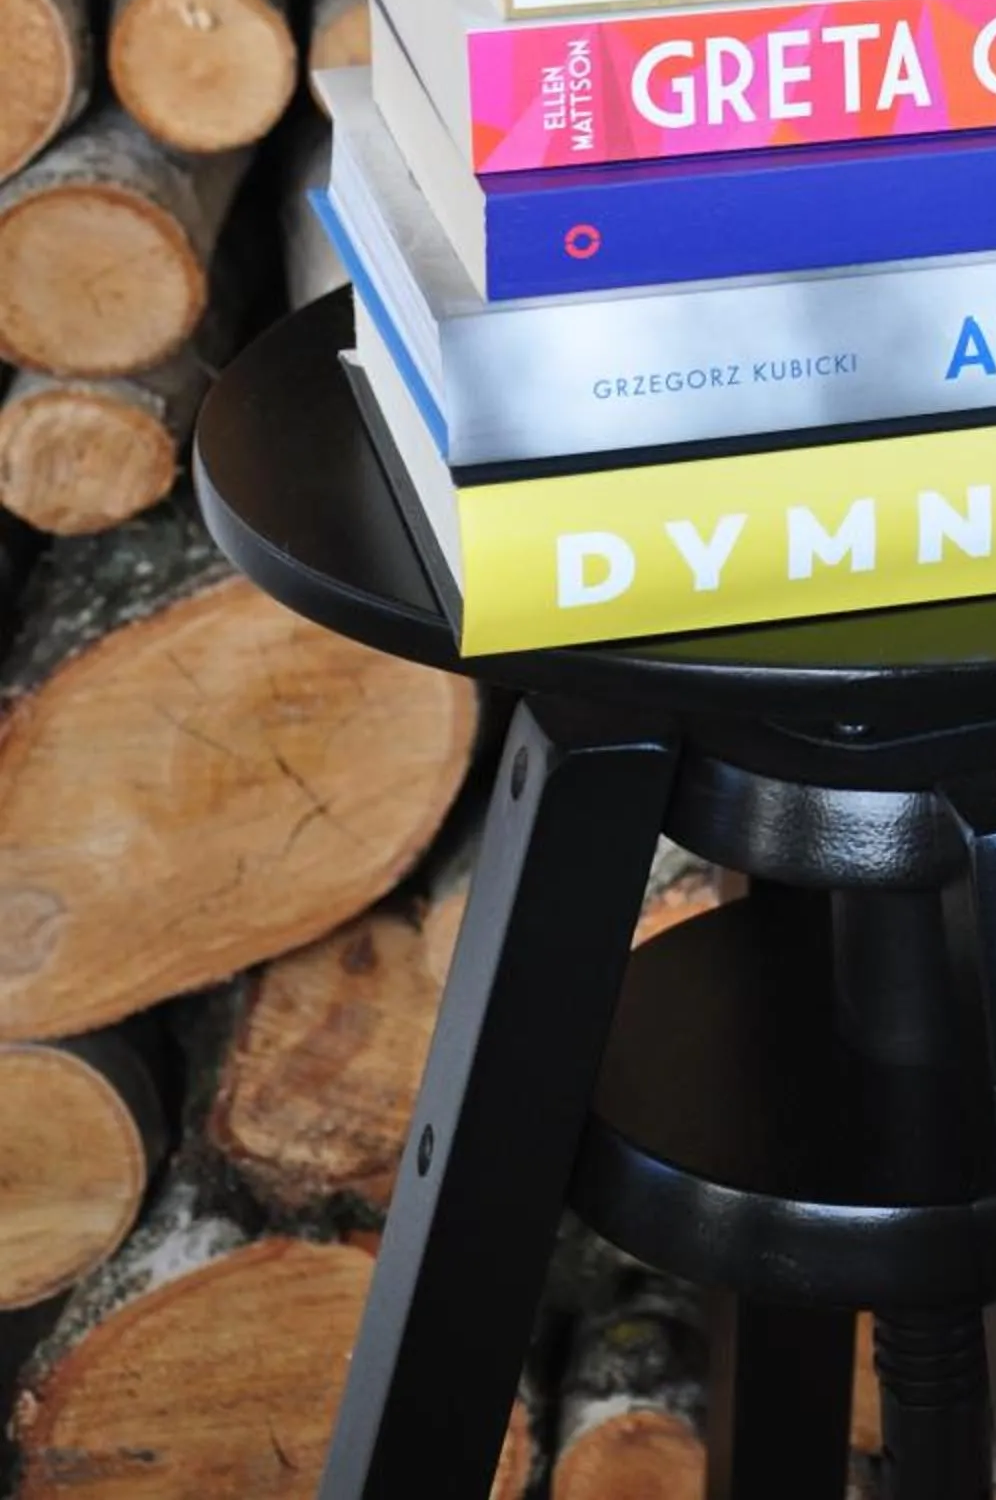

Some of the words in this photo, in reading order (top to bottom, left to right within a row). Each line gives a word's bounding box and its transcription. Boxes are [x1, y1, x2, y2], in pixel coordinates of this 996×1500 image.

[542, 65, 566, 131] ELLEN
[567, 39, 594, 152] MATTSON
[631, 21, 932, 128] GRETA
[593, 363, 743, 400] GRZEGORZ
[753, 352, 859, 383] KUBICKI
